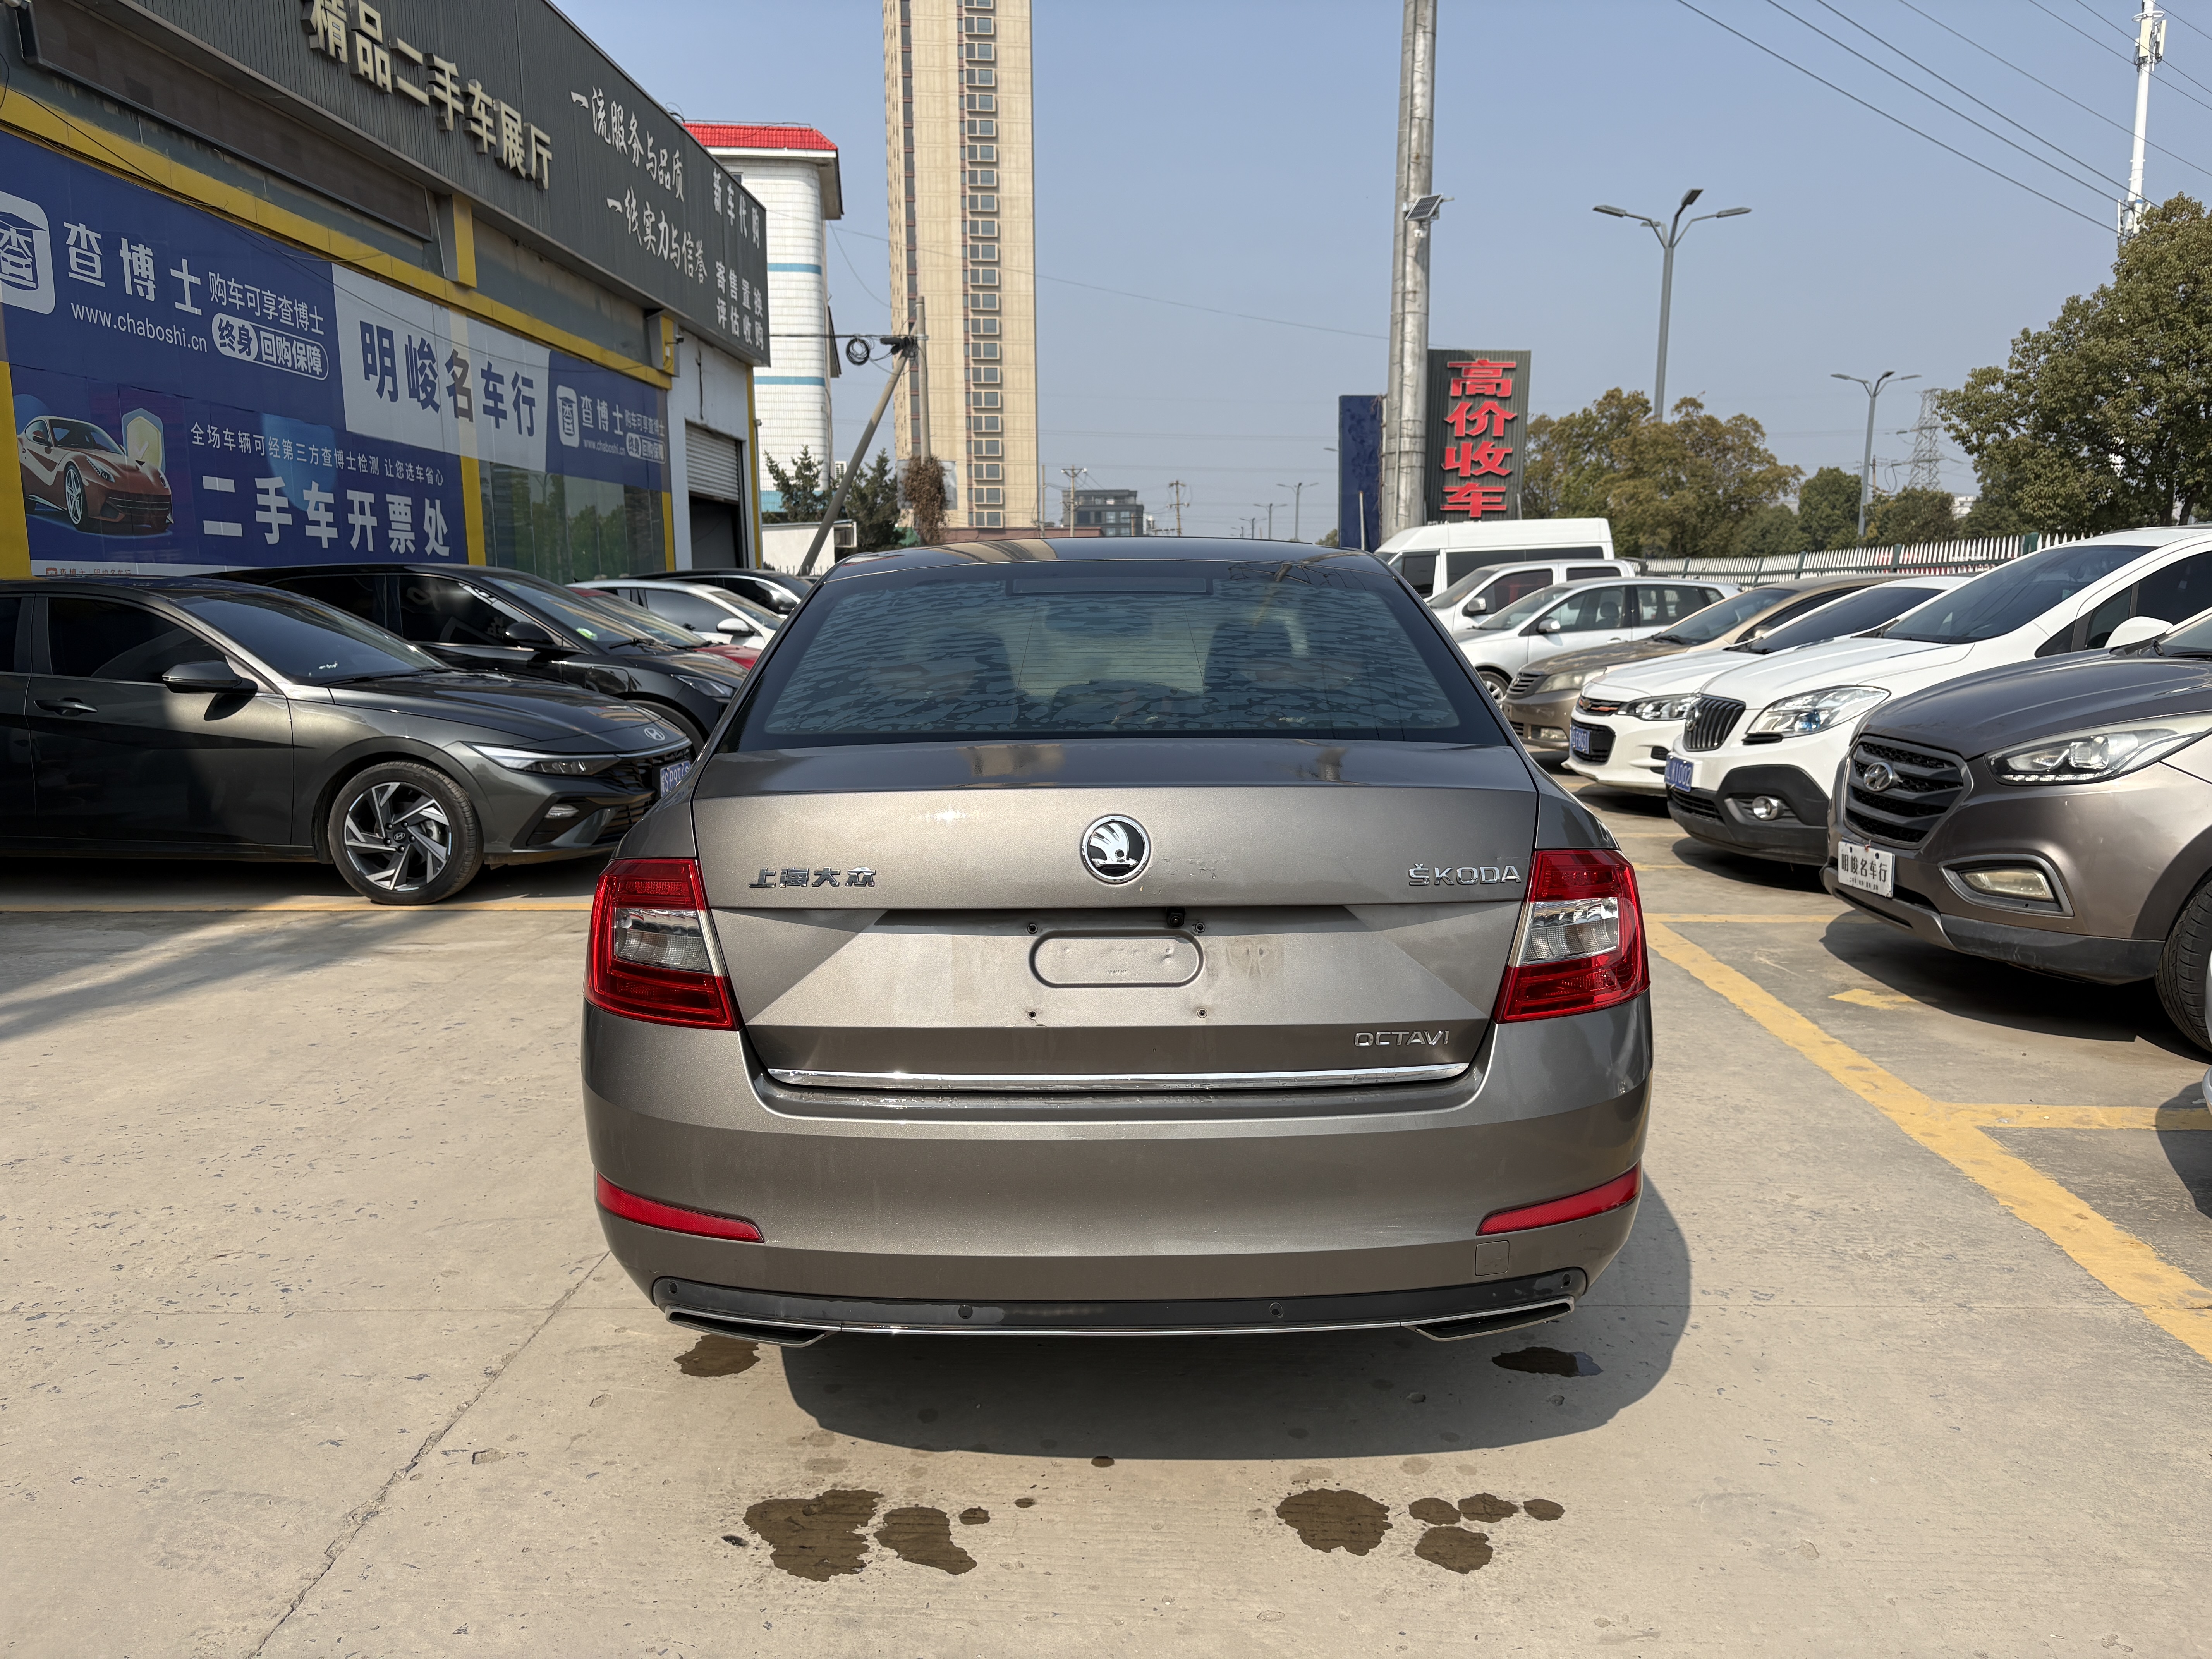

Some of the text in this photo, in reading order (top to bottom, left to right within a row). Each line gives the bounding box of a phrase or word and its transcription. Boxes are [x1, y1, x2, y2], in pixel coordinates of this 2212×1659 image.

[305, 0, 552, 190] 精品二手车展厅
[571, 86, 684, 202] 一流服务与品质
[607, 186, 708, 285] 一线实力与信誉
[64, 222, 202, 315] 查博士
[71, 302, 207, 352] www.chaboshi.cn
[208, 271, 325, 335] 购车可享查博士
[359, 320, 536, 437] 明峻名车行
[580, 395, 624, 436] 查博士
[1440, 359, 1518, 518] 高价收车
[191, 422, 444, 486] 全场车辆可经第三方查博士检测 让您选车省心
[202, 475, 450, 557] 二手车开票处
[749, 866, 876, 888] 上海大众
[1408, 863, 1522, 886] ŠKODA
[1841, 854, 1887, 883] 明峻名车行
[1354, 1030, 1449, 1047] OCTAVI
